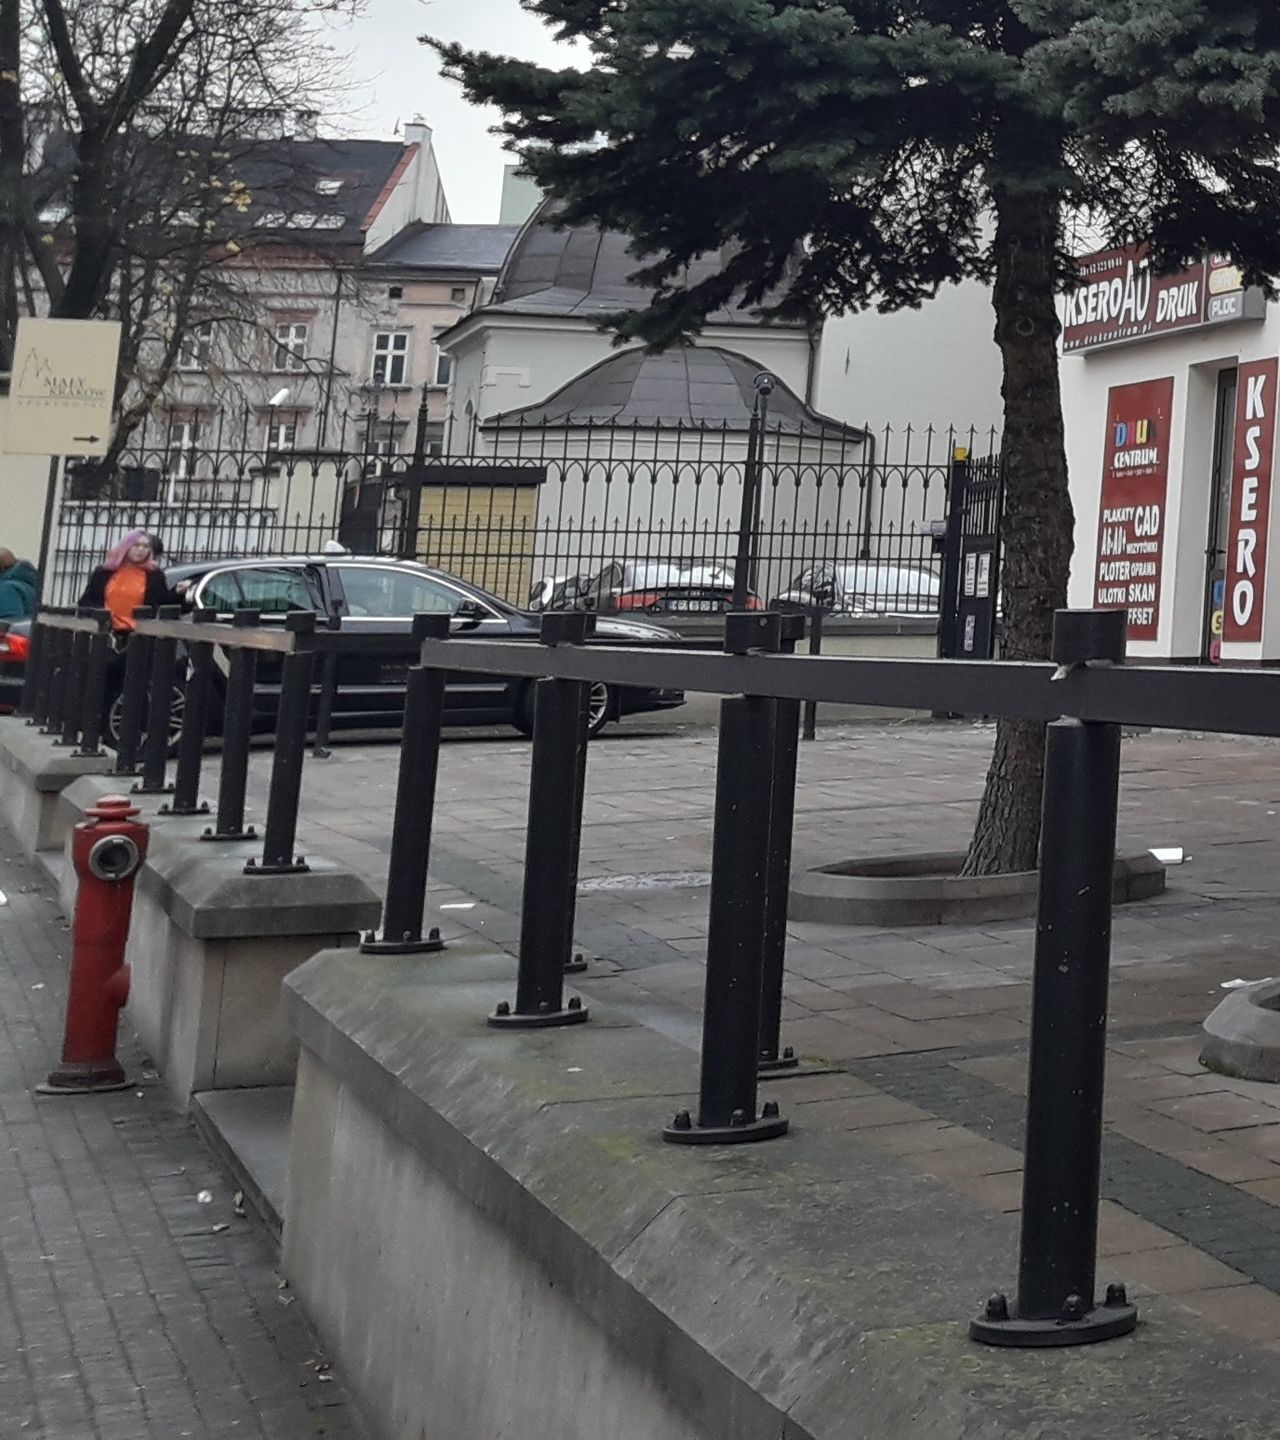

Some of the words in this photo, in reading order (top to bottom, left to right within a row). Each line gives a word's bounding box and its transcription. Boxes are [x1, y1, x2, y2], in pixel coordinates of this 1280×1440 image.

[1065, 277, 1123, 328] KSERO
[1156, 281, 1199, 323] DRUK
[1113, 447, 1158, 469] CENTRUM
[1232, 373, 1266, 627] KSERO
[1103, 506, 1135, 523] PLAKATY
[1134, 504, 1160, 537] CAD
[1099, 561, 1130, 581] PLOTER
[1098, 587, 1126, 604] ULOTKI
[1128, 582, 1156, 602] SKAN
[1127, 607, 1154, 625] FFSET
